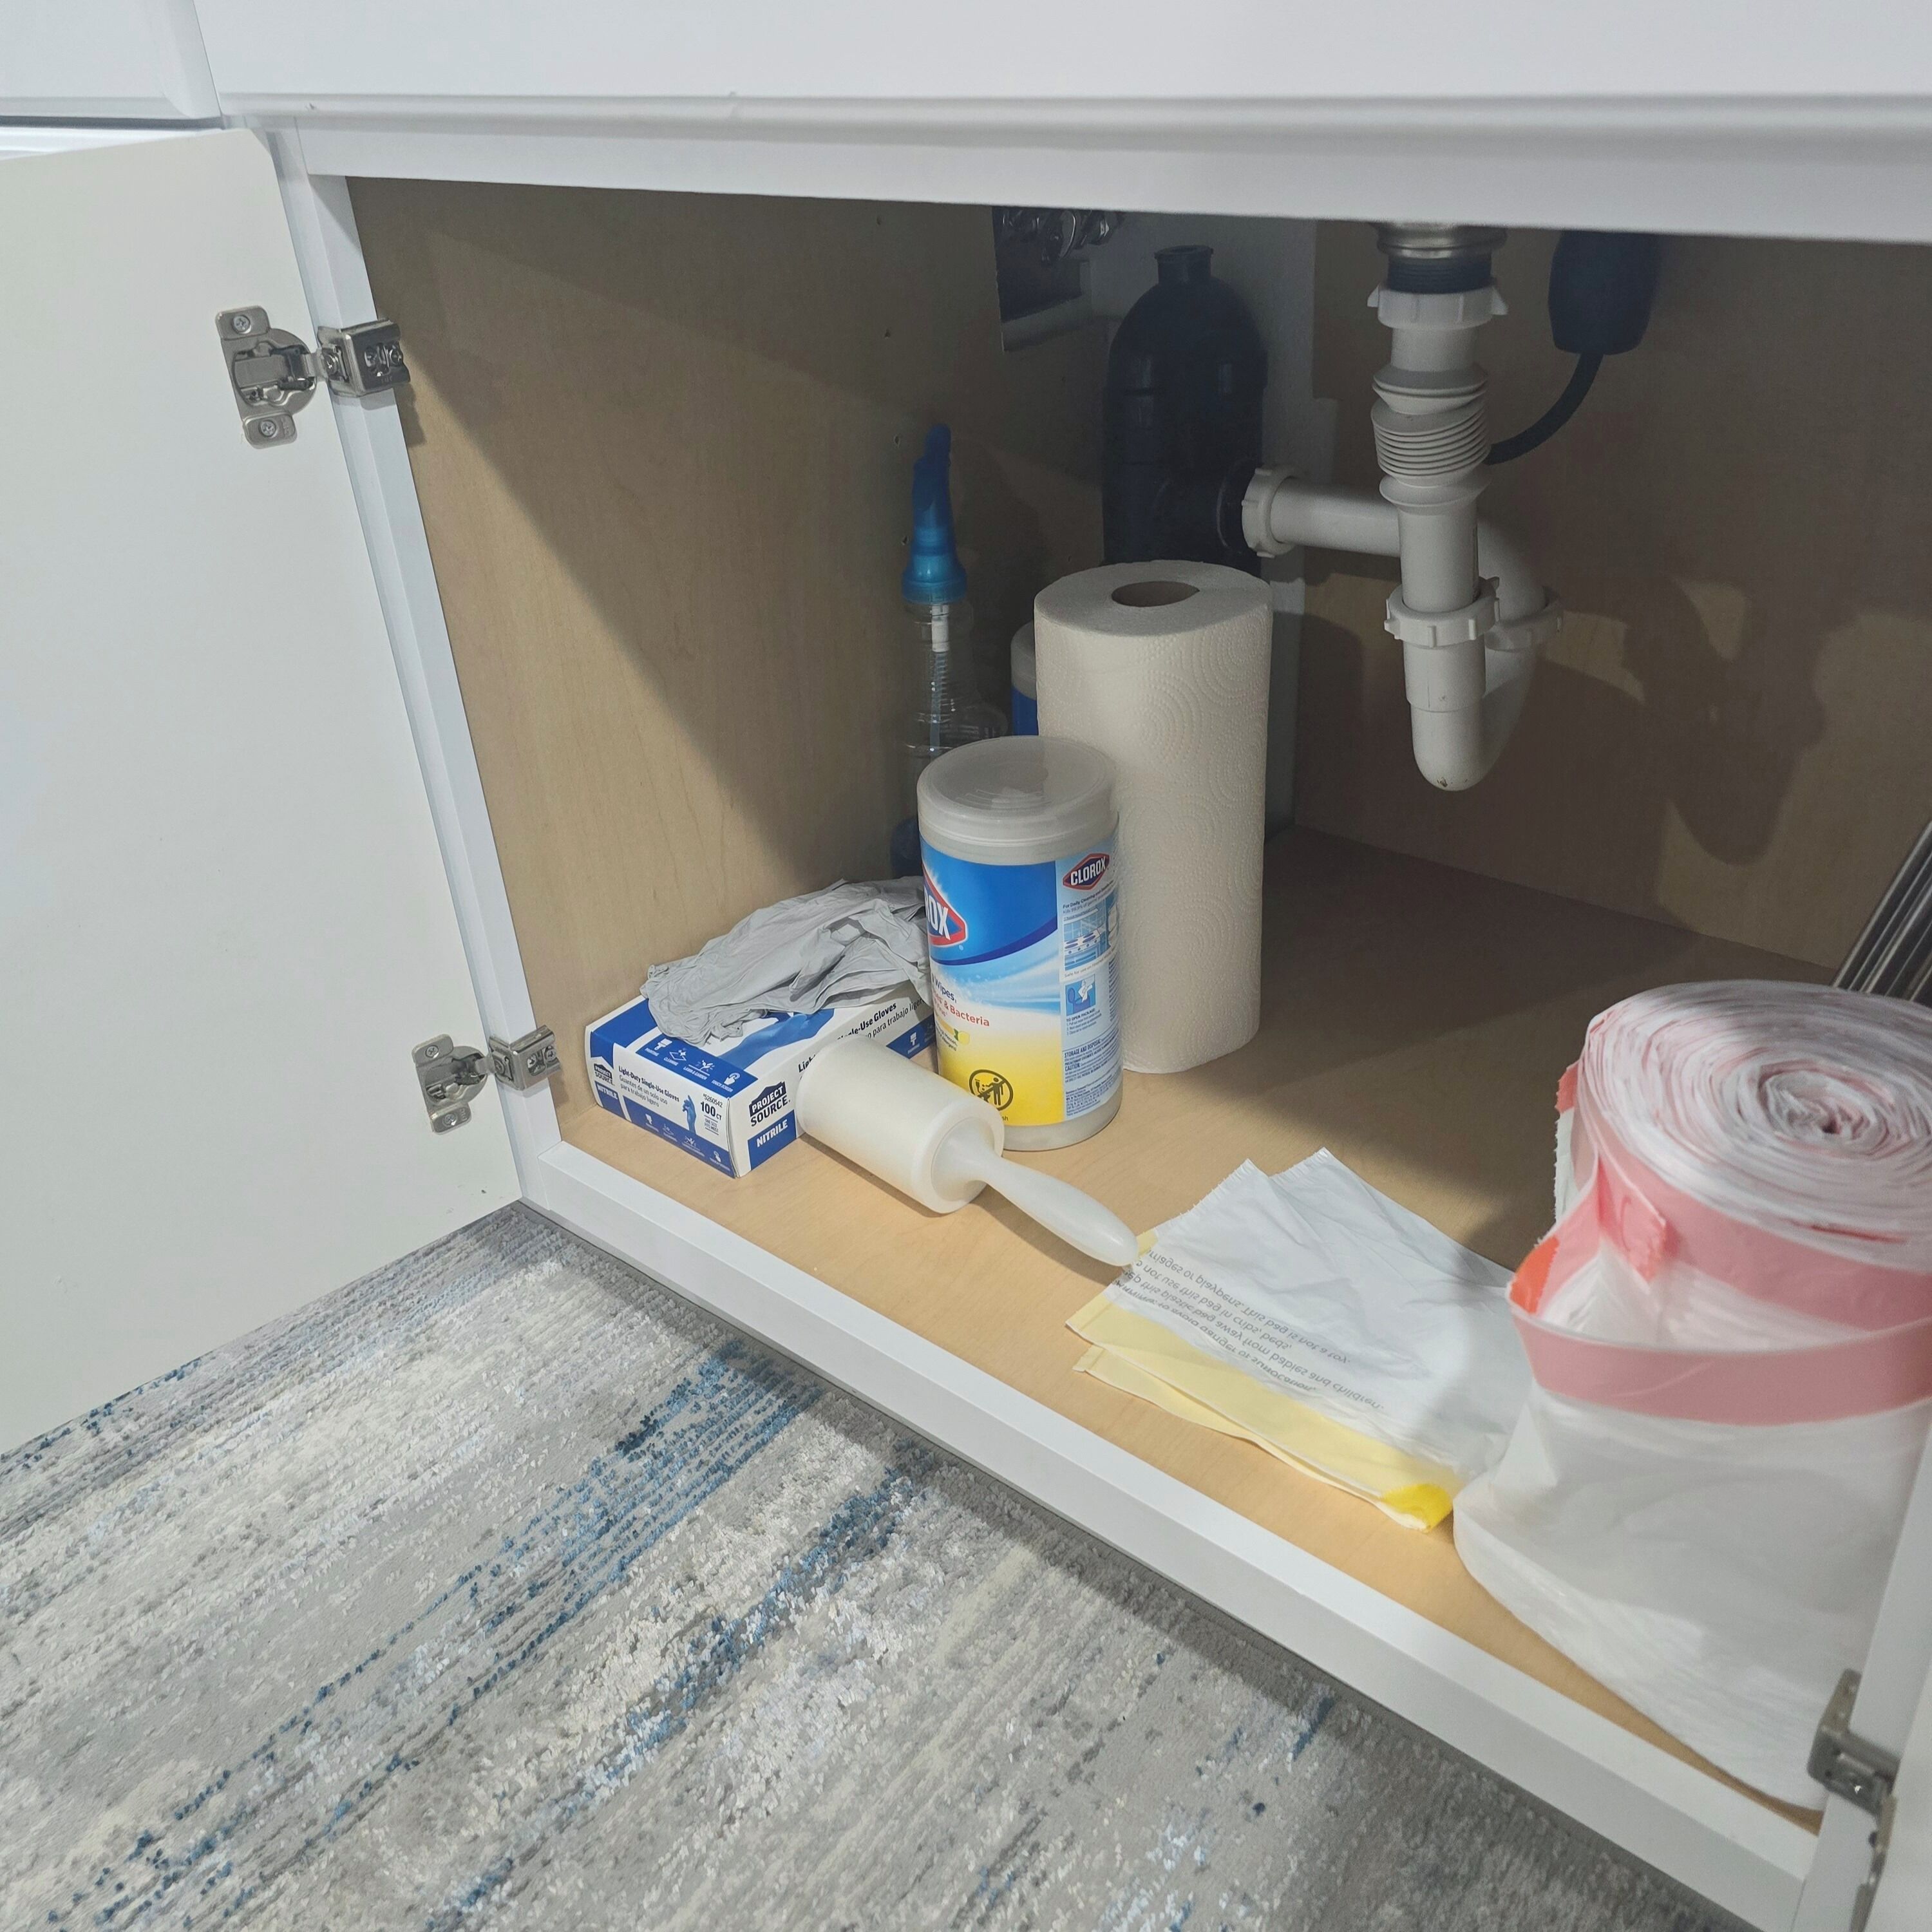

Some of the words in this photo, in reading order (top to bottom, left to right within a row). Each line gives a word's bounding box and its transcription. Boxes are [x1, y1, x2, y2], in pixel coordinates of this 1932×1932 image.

[1070, 855, 1106, 886] CLOROX
[873, 1023, 886, 1037] para
[887, 1007, 909, 1026] trabajo
[909, 998, 923, 1011] liger
[874, 1002, 896, 1021] Gloves
[944, 1000, 949, 1010] &
[950, 1005, 990, 1027] Bacteria
[618, 1066, 641, 1083] Light-Duty
[641, 1077, 664, 1094] Single-Use
[664, 1090, 679, 1102] Gloves
[620, 1075, 637, 1088] Guantes
[650, 1091, 659, 1101] solo
[620, 1083, 630, 1092] para
[630, 1087, 646, 1101] trabajo
[646, 1095, 659, 1107] ligero
[700, 1101, 716, 1117] 100
[752, 1086, 783, 1113] PROJECT
[757, 1119, 788, 1148] NITRILE
